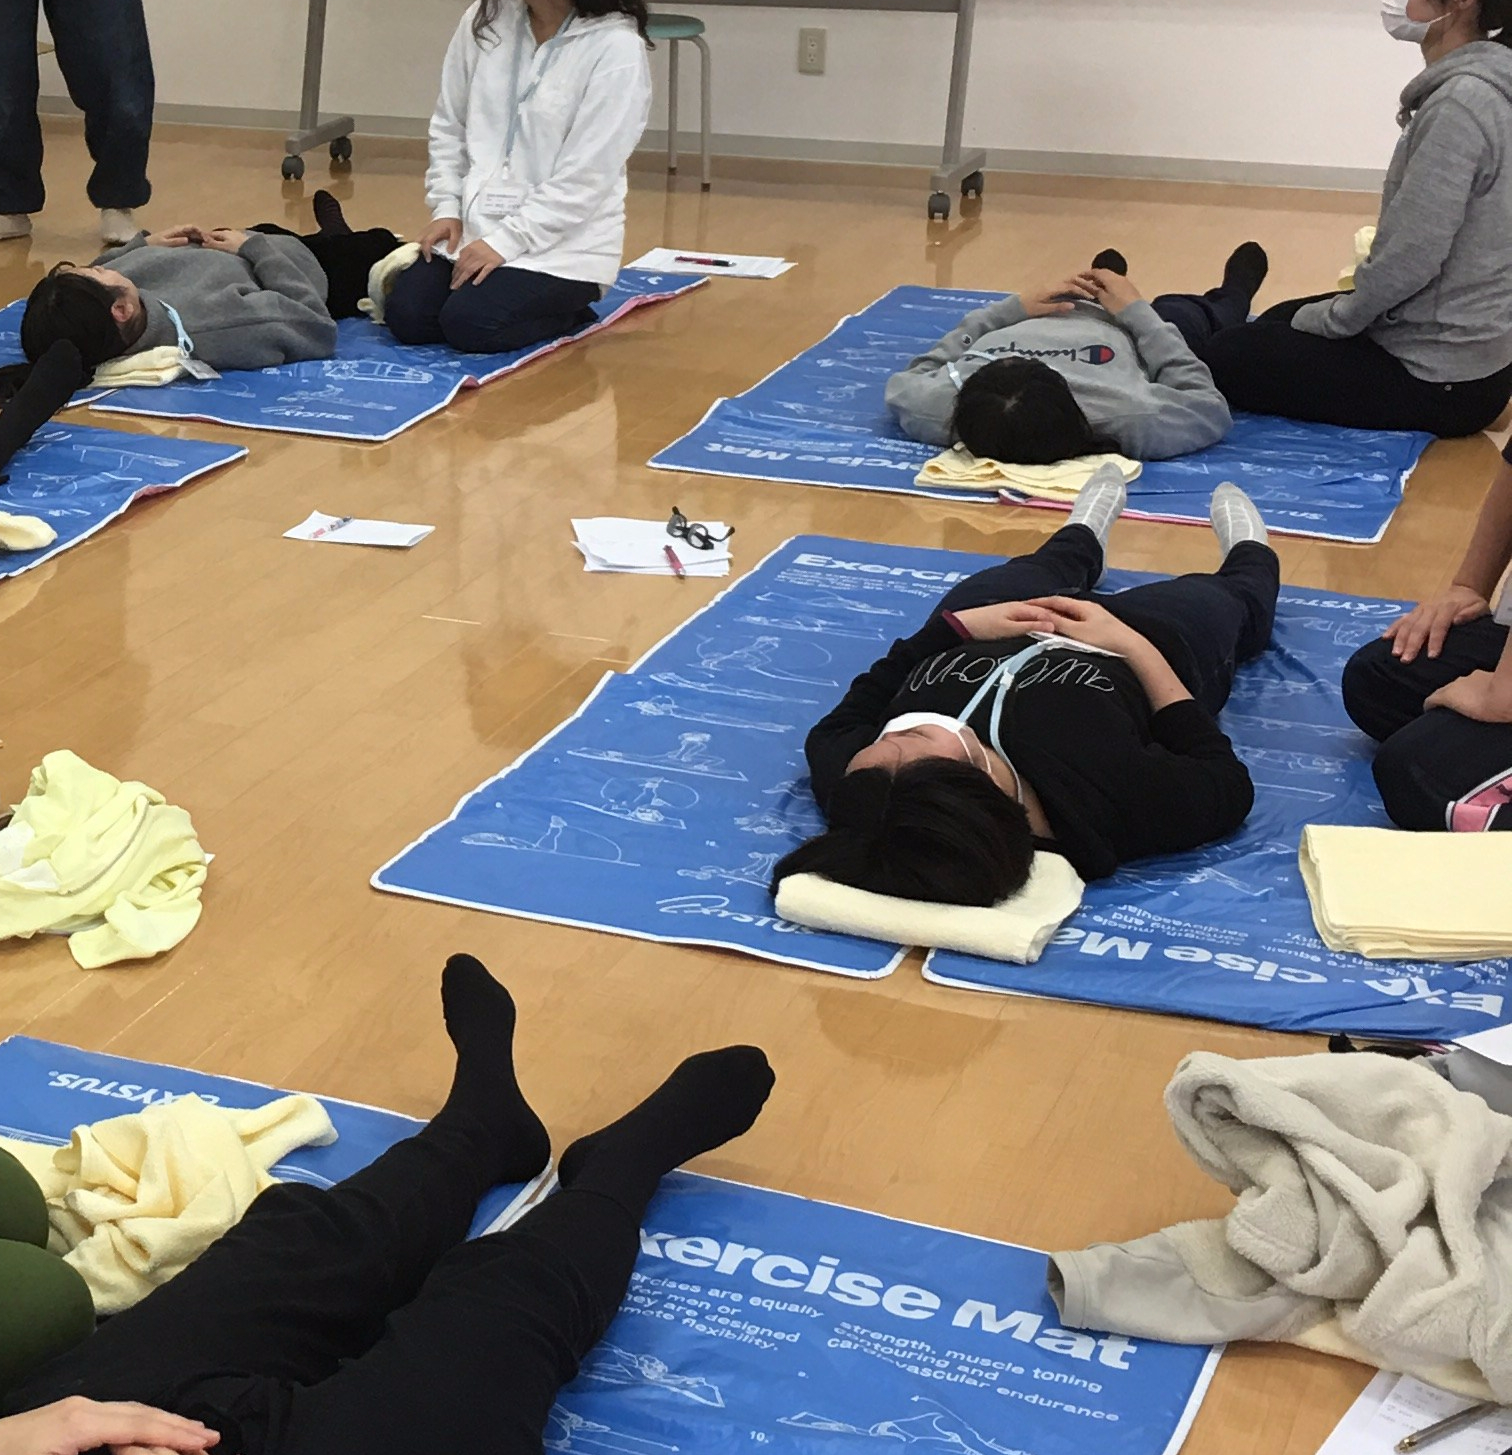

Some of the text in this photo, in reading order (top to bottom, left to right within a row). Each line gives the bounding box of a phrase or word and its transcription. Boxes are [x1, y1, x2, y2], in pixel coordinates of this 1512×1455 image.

[640, 1227, 1138, 1371] xercise Mat
[666, 1292, 711, 1311] men
[717, 1305, 742, 1317] or
[707, 1286, 744, 1302] are
[748, 1295, 824, 1319] equally
[663, 1301, 699, 1318] are
[704, 1313, 801, 1343] designed
[833, 1326, 1000, 1382] contouring and
[945, 1349, 1025, 1375] muscle
[1032, 1367, 1103, 1394] toning
[996, 1386, 1120, 1422] endurance
[749, 1430, 769, 1444] 10.
